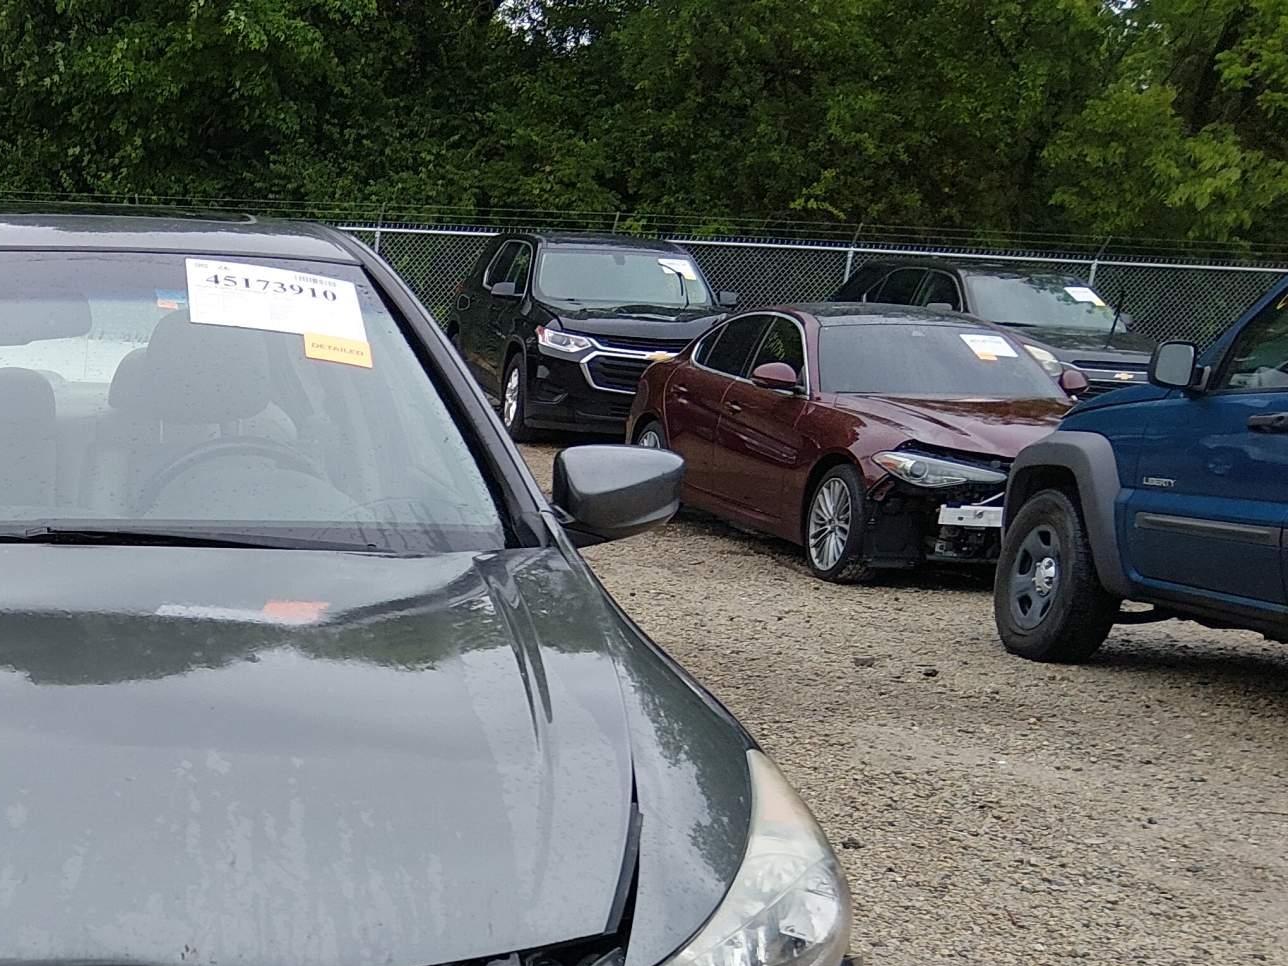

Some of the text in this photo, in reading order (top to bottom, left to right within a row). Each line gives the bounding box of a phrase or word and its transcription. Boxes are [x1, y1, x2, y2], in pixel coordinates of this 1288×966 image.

[205, 273, 338, 302] 45173910
[311, 342, 364, 356] DETAILED
[1143, 476, 1176, 487] LIBERTY
